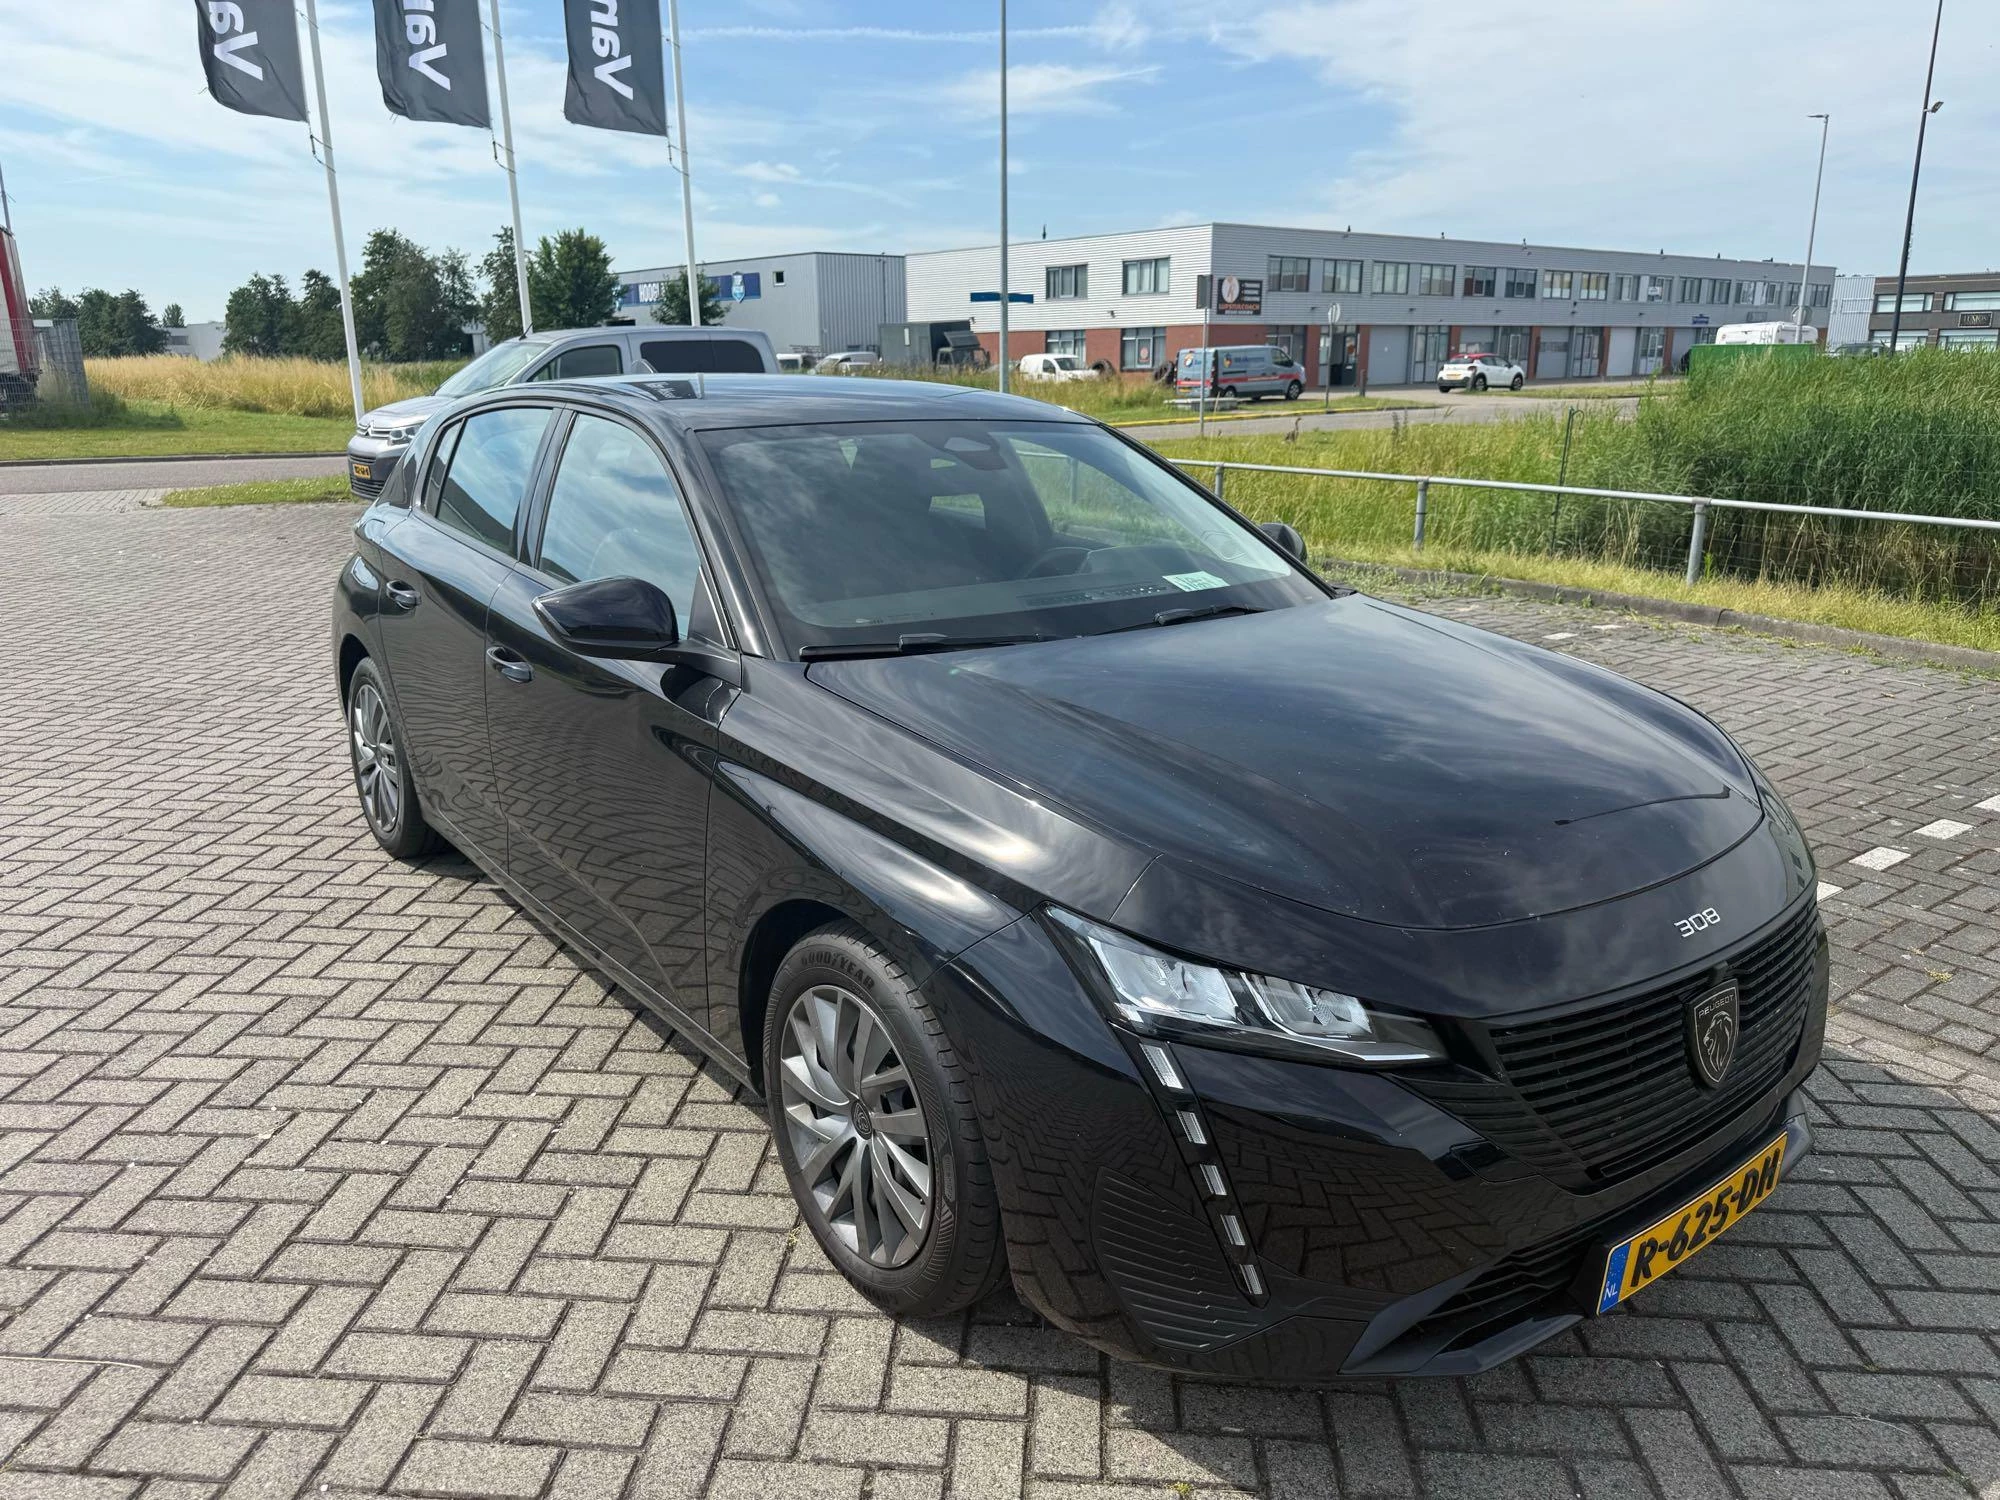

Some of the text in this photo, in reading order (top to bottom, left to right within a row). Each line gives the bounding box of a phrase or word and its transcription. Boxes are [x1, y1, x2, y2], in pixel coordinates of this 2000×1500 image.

[1673, 907, 1721, 938] 308
[1698, 994, 1734, 1019] PEUGEOT
[1630, 1148, 1781, 1288] R-625-DH
[1603, 1284, 1618, 1301] NL
